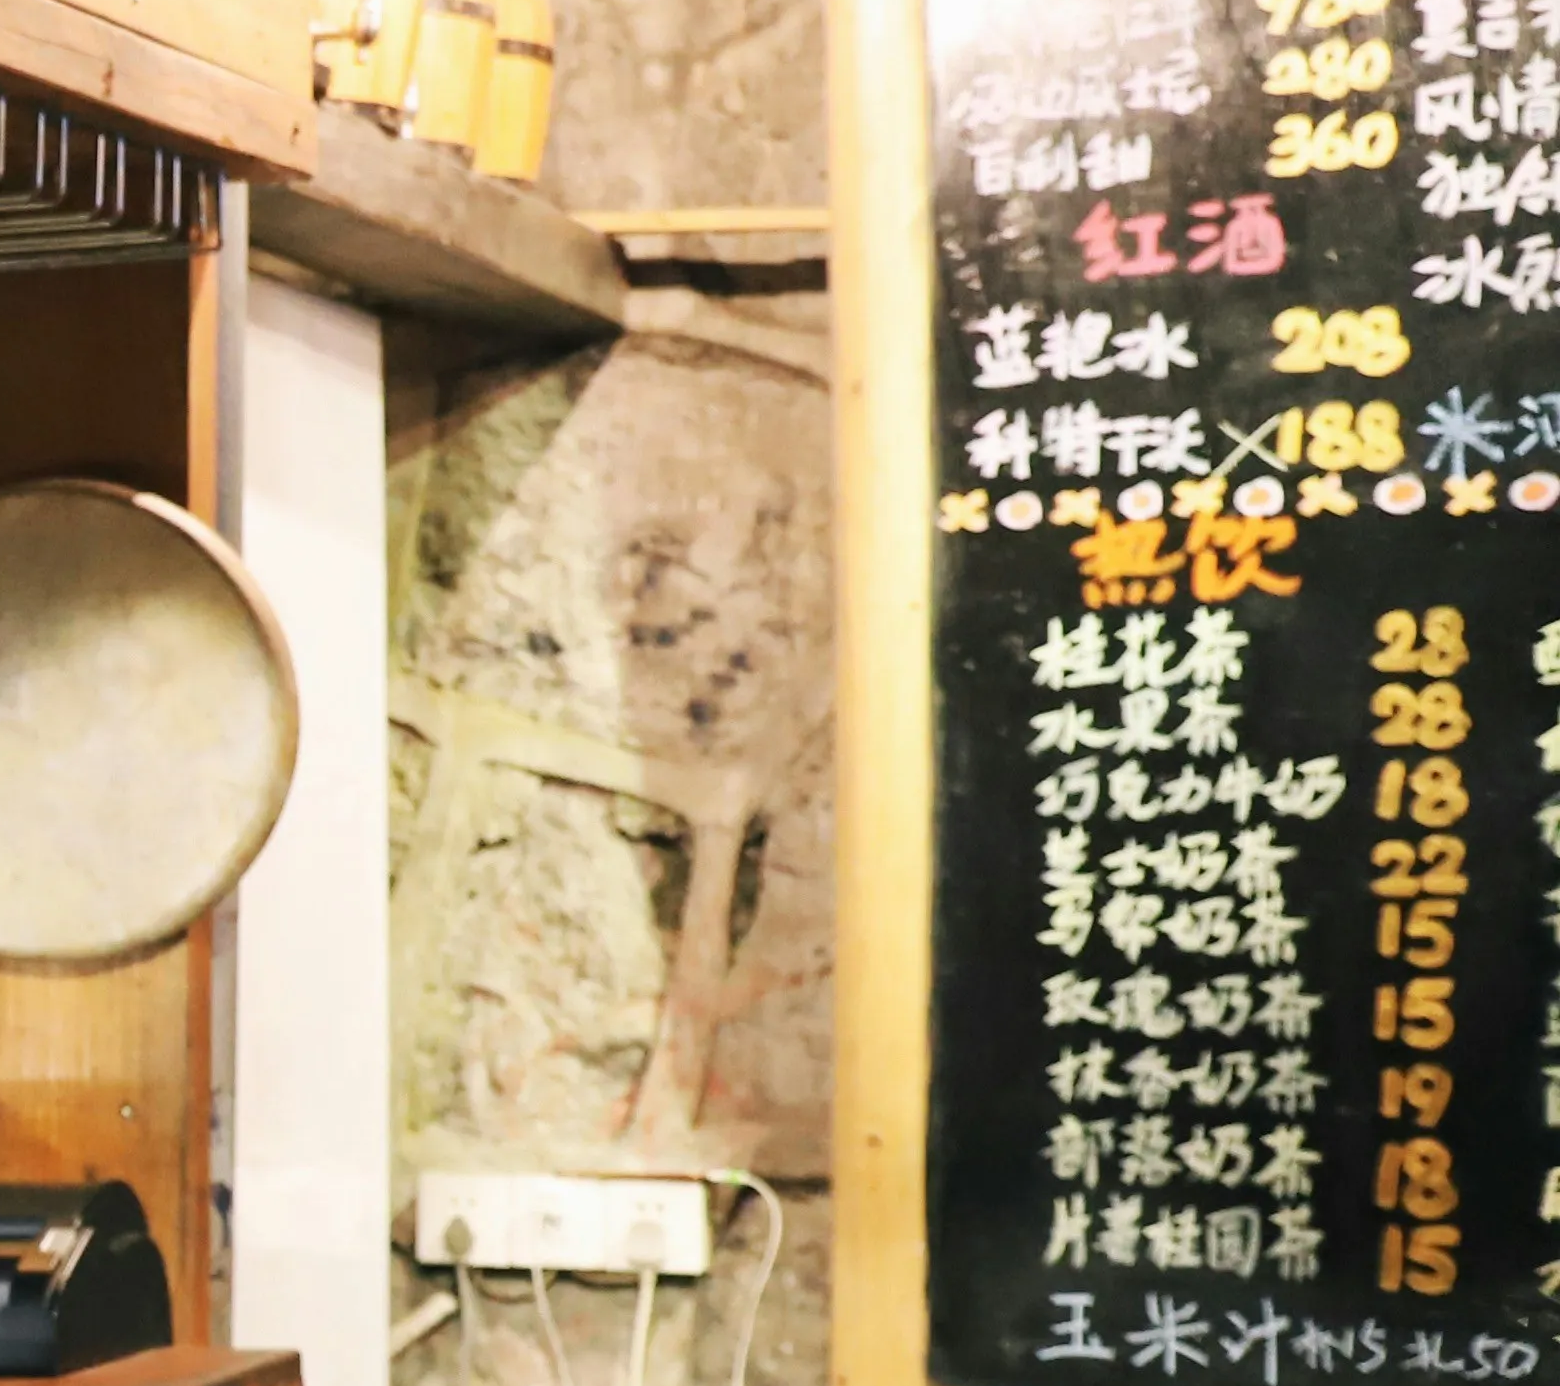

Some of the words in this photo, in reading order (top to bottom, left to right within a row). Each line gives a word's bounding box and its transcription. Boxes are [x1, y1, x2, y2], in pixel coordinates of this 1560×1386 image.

[1262, 37, 1394, 102] 280
[1264, 110, 1399, 180] 360
[1072, 196, 1288, 283] 红酒
[1270, 304, 1412, 378] 208
[1274, 400, 1408, 473] 188
[1070, 510, 1303, 608] 热饮
[1028, 604, 1251, 691] 桂花茶
[1369, 604, 1470, 678] 28
[1024, 685, 1244, 758] 水果茶
[1368, 680, 1473, 751] 28
[1033, 754, 1348, 826] 巧克力牛奶
[1374, 754, 1470, 830] 18
[1038, 822, 1302, 901] 芝士奶茶
[1369, 837, 1470, 901] 22
[1374, 898, 1460, 971] 15
[1040, 963, 1326, 1042] 玫瑰奶茶
[1373, 976, 1457, 1051] 15
[1377, 1062, 1455, 1128] 19
[1038, 1112, 1325, 1199] 部落奶茶
[1375, 1137, 1460, 1222] 18
[1380, 1225, 1462, 1297] 15
